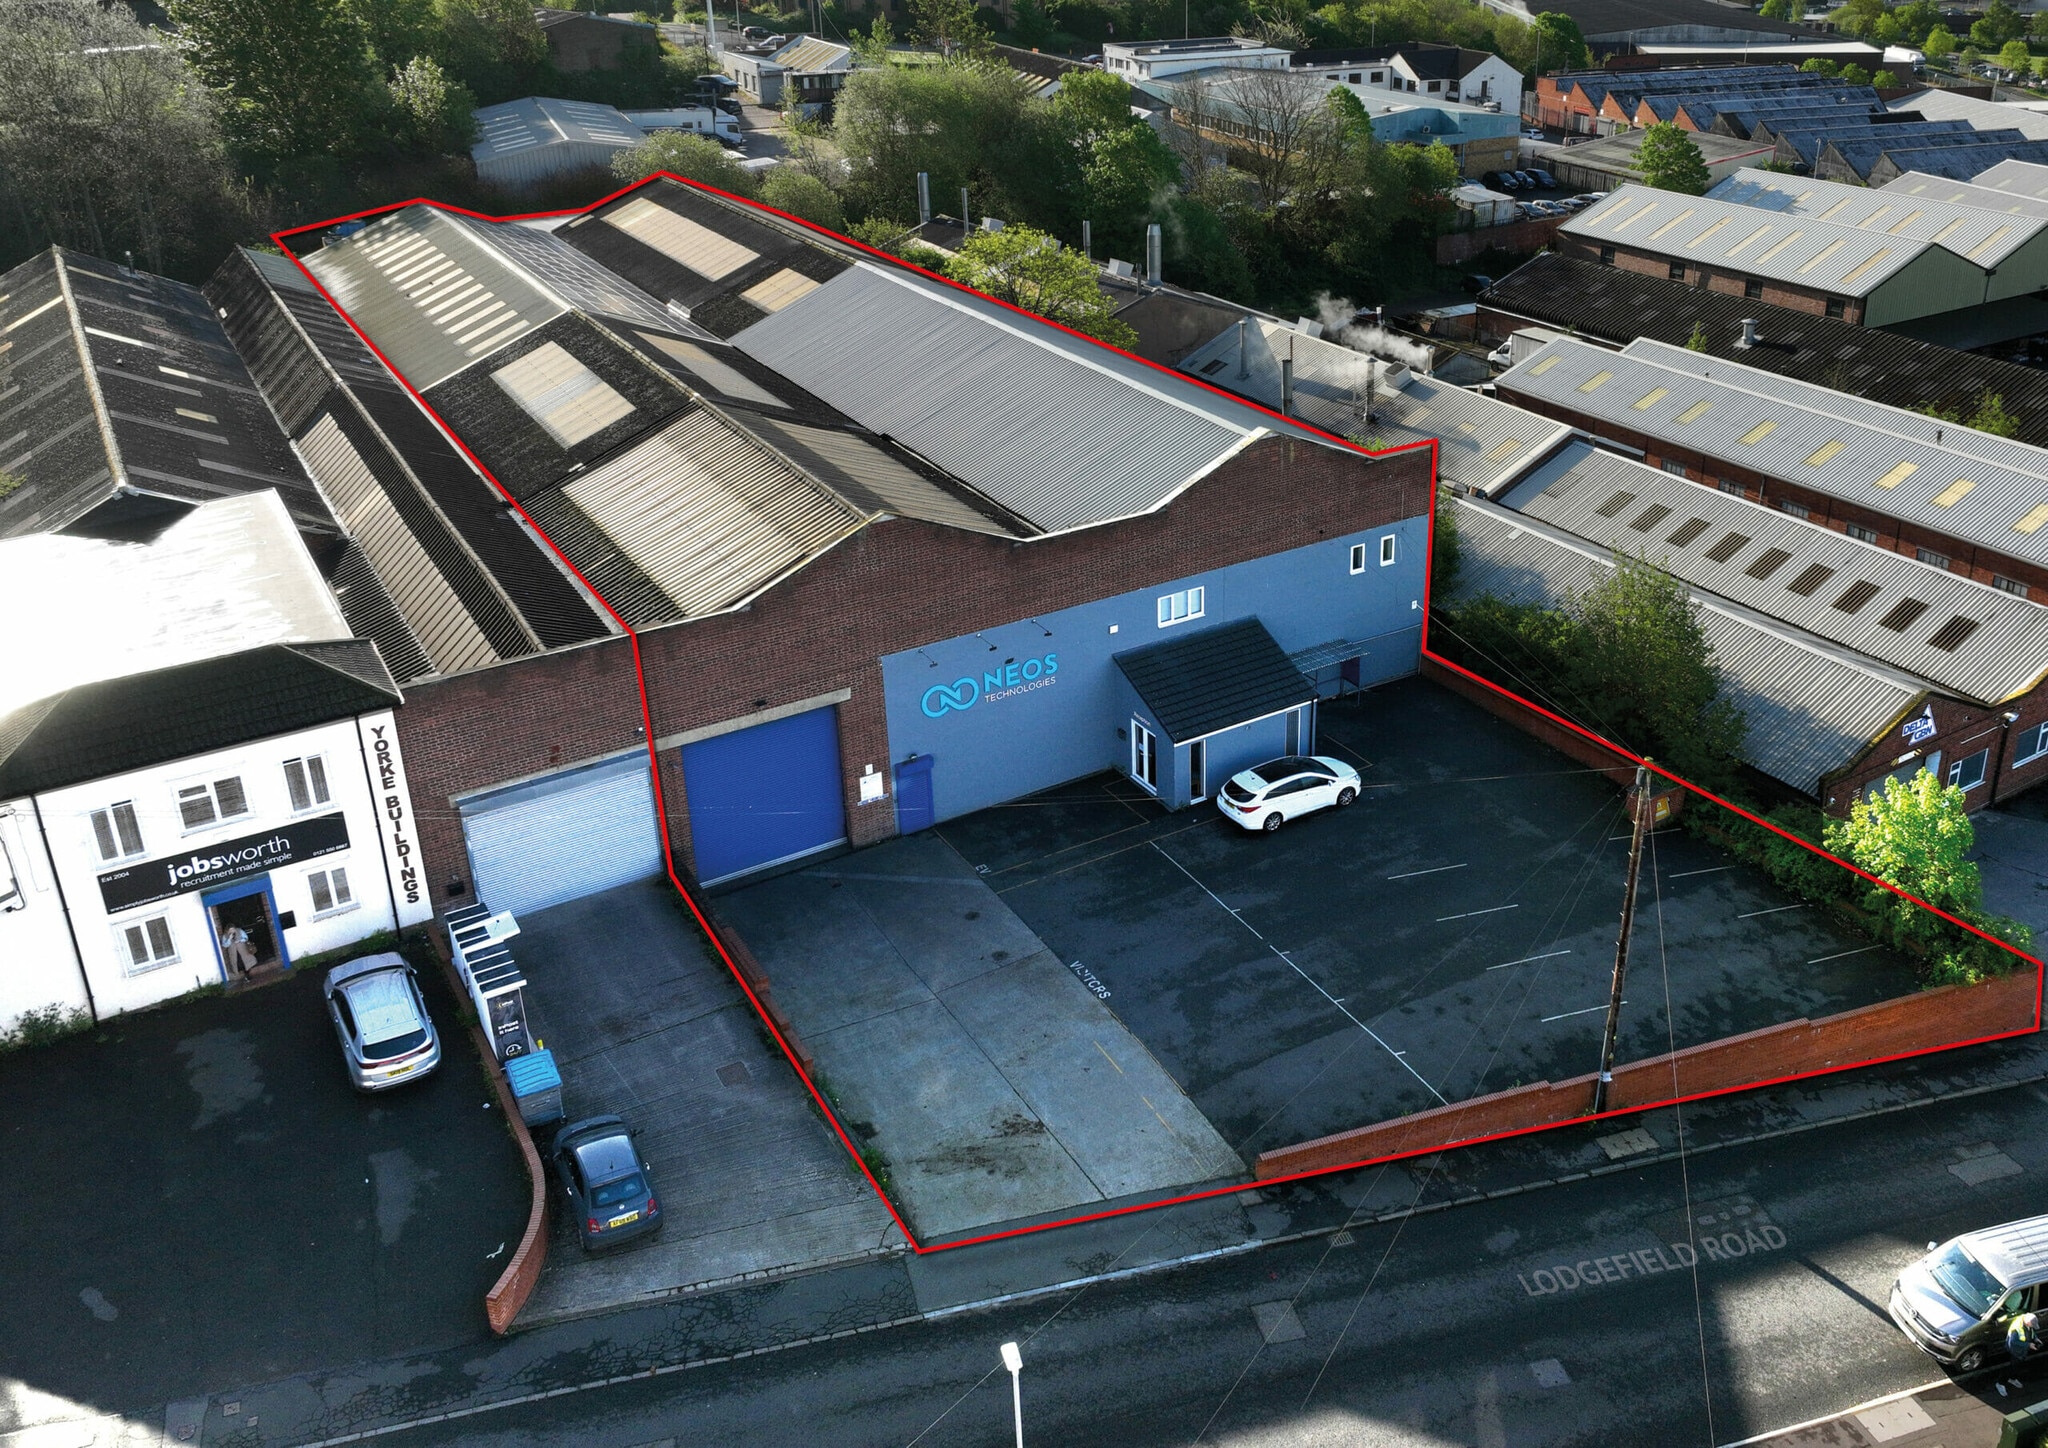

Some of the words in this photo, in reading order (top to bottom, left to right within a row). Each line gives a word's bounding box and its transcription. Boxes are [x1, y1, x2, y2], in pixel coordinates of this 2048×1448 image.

[983, 653, 1059, 693] NEOS
[984, 676, 1057, 703] TECHNOLOGIES
[1903, 718, 1929, 735] DELTA
[1914, 725, 1933, 740] GBN
[371, 725, 396, 790] YORKE
[385, 795, 420, 904] BUILDINGS
[113, 871, 130, 880] 2004
[167, 835, 291, 886] jobsworth
[180, 868, 235, 889] recruitment
[236, 860, 262, 873] made
[263, 852, 293, 867] simple
[1517, 1242, 1699, 1297] LODGEFIELD
[1700, 1225, 1788, 1261] ROAD
